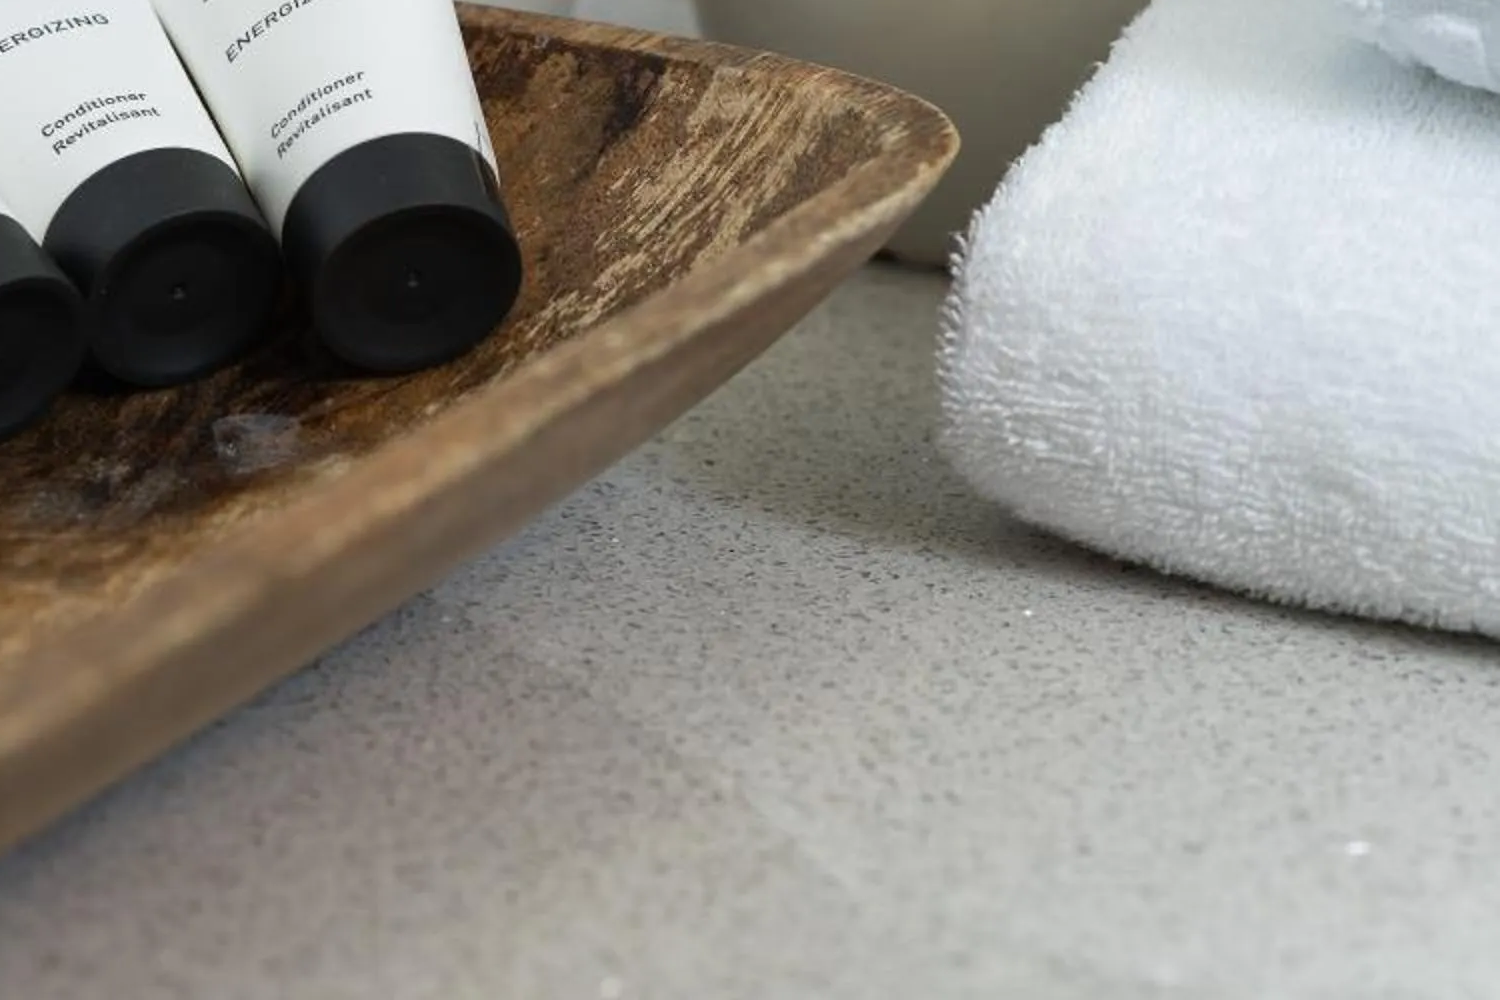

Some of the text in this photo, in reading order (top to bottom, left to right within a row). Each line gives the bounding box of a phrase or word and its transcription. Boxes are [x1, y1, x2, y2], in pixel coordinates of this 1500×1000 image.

[41, 93, 147, 138] Conditioner
[52, 107, 161, 155] Revitalisant
[271, 71, 365, 139] Conditioner
[277, 89, 373, 160] Revitalisant
